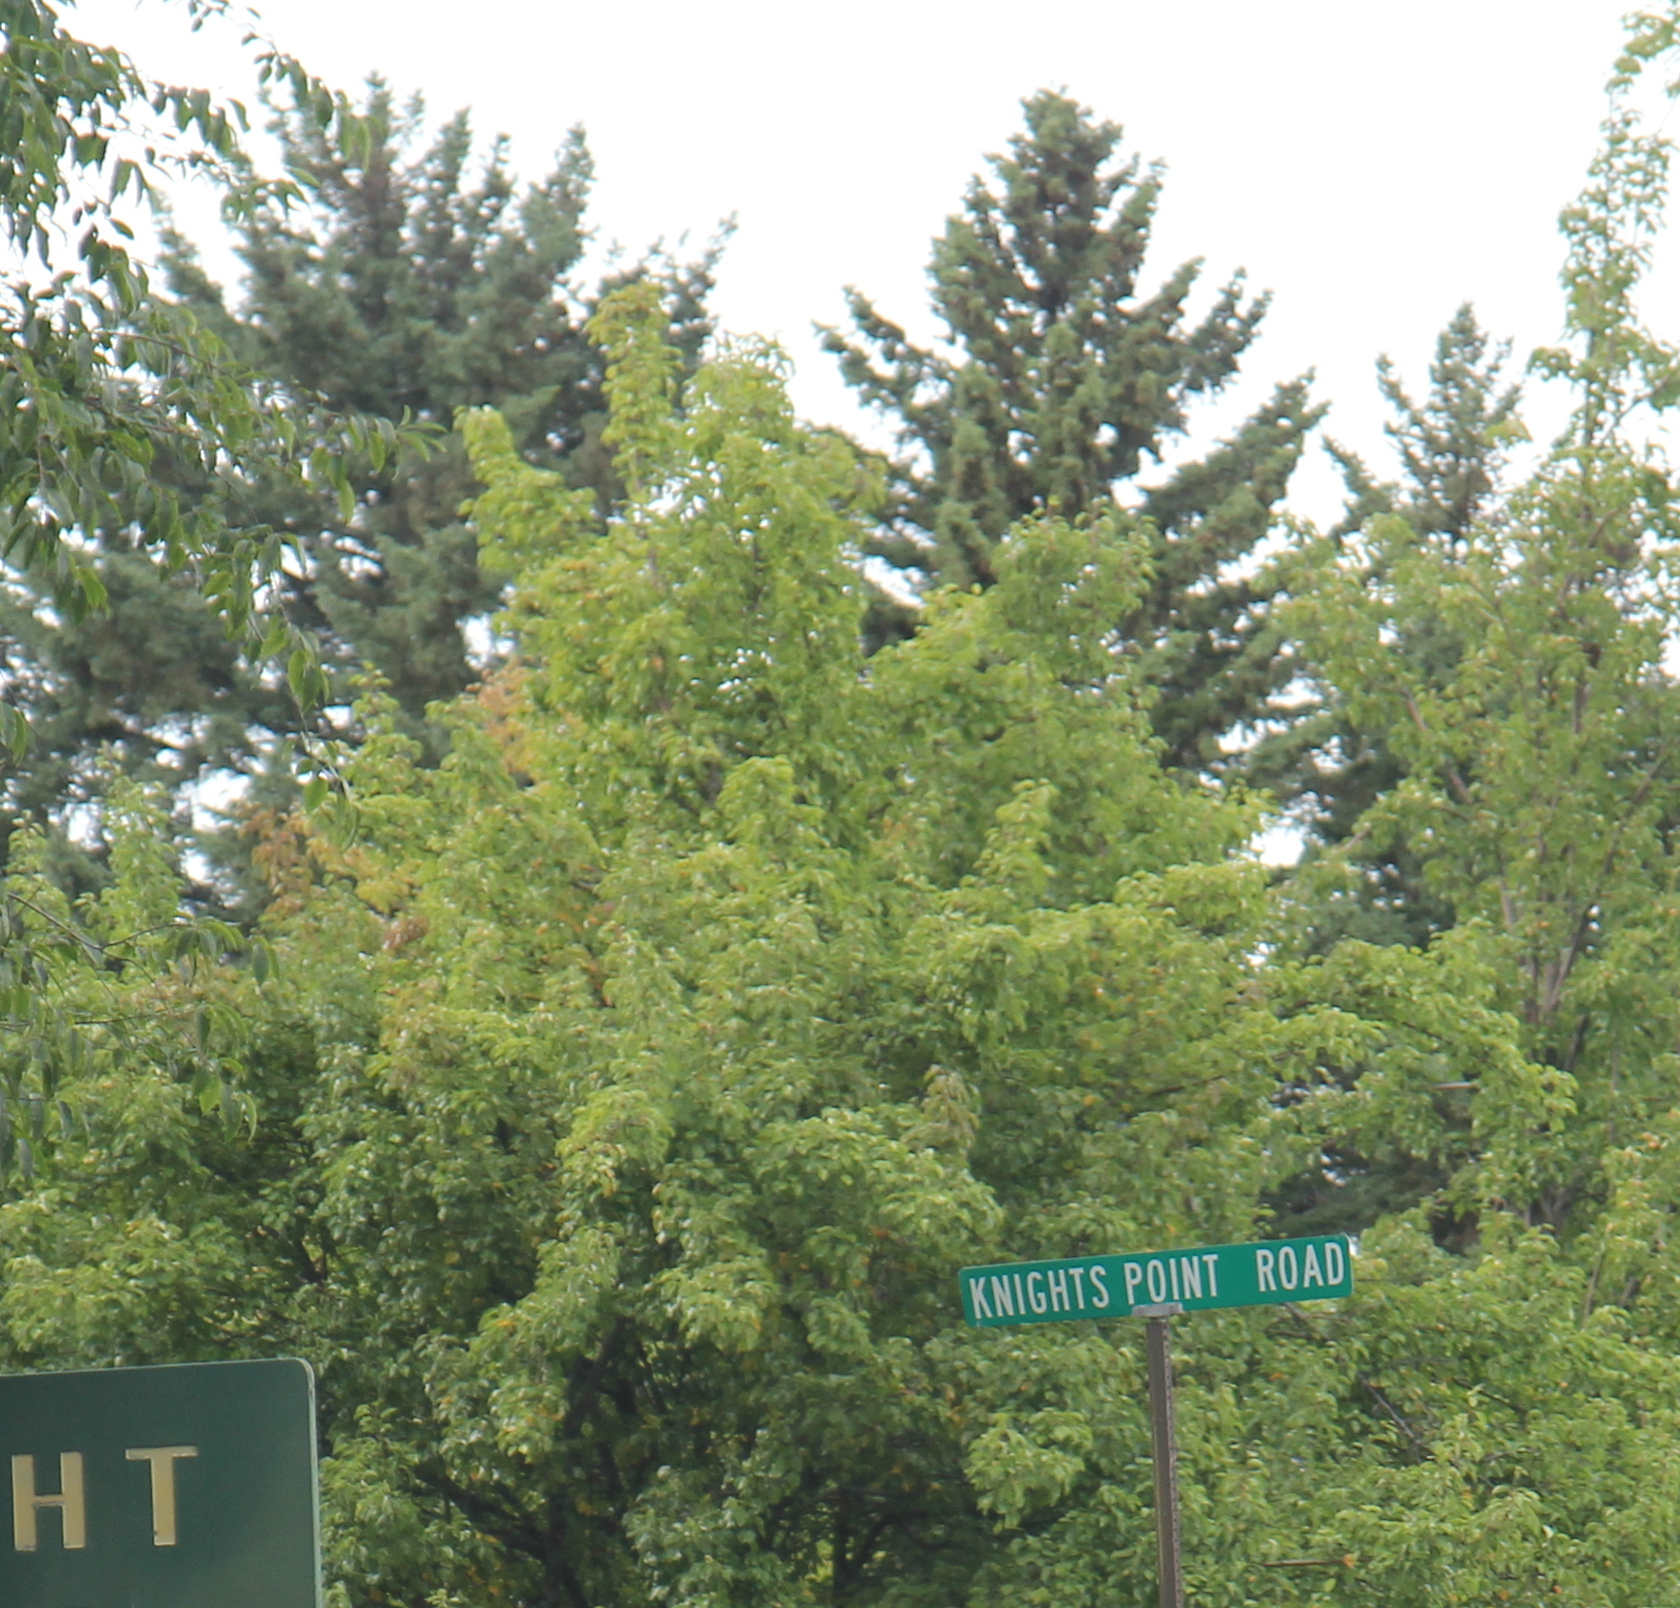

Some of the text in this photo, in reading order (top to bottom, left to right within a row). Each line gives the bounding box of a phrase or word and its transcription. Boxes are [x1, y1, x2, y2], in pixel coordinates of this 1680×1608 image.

[969, 1242, 1345, 1319] KNIGHTS POINT ROAD
